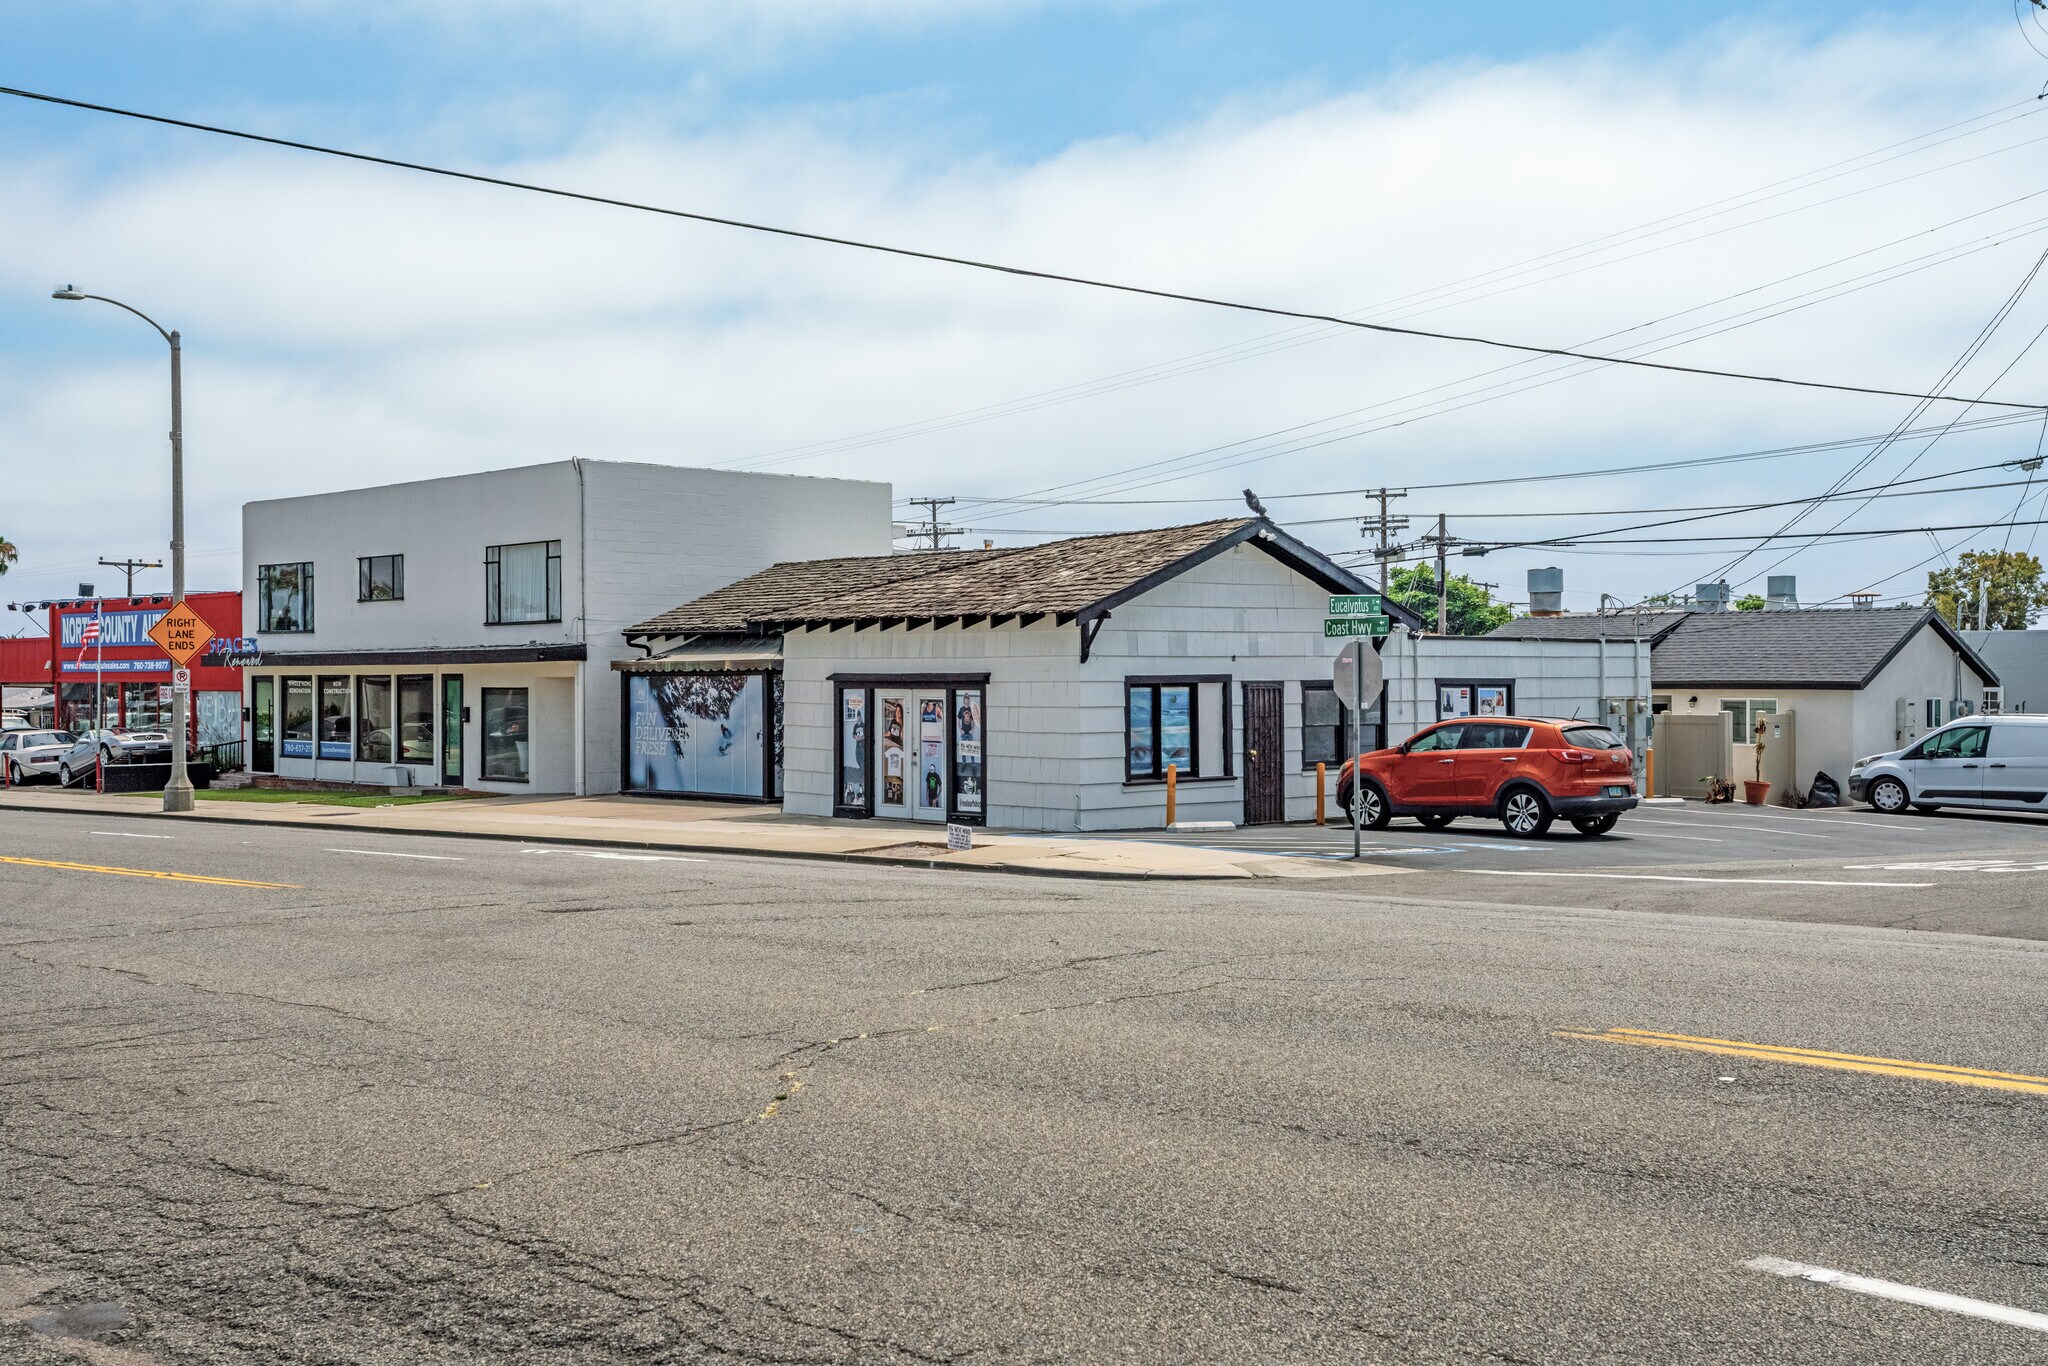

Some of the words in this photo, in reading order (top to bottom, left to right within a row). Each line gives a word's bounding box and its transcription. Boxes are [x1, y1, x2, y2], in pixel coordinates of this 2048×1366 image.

[1330, 598, 1369, 614] Eucalyptus
[62, 616, 95, 644] NORT
[166, 618, 197, 628] RIGHT
[1325, 620, 1350, 636] Coast
[1351, 619, 1372, 637] Hwy
[168, 630, 195, 639] LANE
[168, 641, 195, 650] ENDS
[209, 637, 258, 653] SPACES
[219, 647, 264, 671] Renewed
[635, 711, 657, 726] FUN
[635, 726, 690, 741] DELIVERED
[635, 740, 668, 756] FRESH
